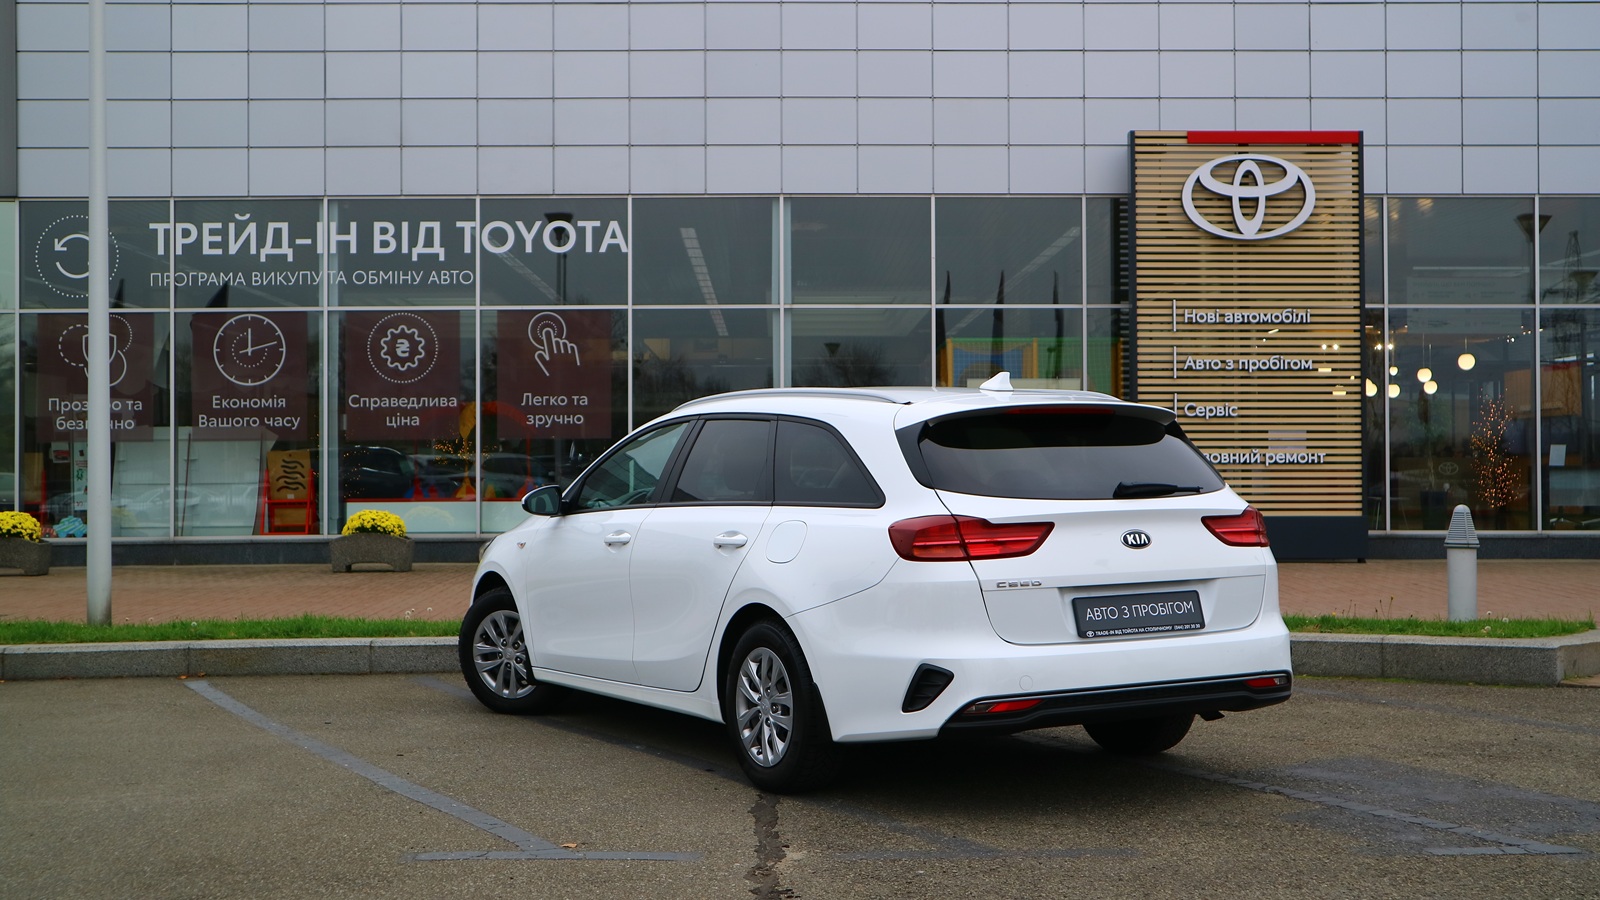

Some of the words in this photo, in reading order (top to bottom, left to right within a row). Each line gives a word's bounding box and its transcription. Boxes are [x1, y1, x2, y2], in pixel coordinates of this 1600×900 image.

[149, 213, 357, 262] ТРЕЙД-ІН
[373, 221, 445, 261] ВІД
[456, 220, 628, 254] TOYOTA
[150, 272, 246, 287] ПРОГРАМА
[252, 271, 322, 286] ВИКУПУ
[326, 271, 347, 285] ТА
[352, 270, 423, 285] ОБМІНУ
[428, 270, 473, 285] АВТО
[1184, 309, 1219, 323] Нові
[1224, 309, 1311, 324] автомобілі
[1184, 356, 1221, 370] Авто
[1226, 359, 1233, 370] з
[1238, 355, 1313, 372] пробігом
[48, 398, 122, 414] Прозо
[126, 400, 143, 411] та
[212, 395, 286, 409] Економія
[348, 394, 457, 409] Справедлива
[521, 393, 567, 407] Легко
[571, 395, 588, 406] та
[1184, 403, 1238, 419] Сервіс
[56, 416, 135, 430] безно
[198, 414, 259, 429] Вашого
[264, 417, 301, 431] часу
[386, 413, 420, 427] ціна
[526, 415, 584, 428] зручно
[1203, 449, 1261, 464] зовний
[1265, 452, 1326, 466] ремонт
[1126, 533, 1149, 545] KIA
[1086, 606, 1119, 621] АВТО
[1121, 605, 1130, 619] З
[1132, 601, 1195, 617] ПРОБІГОМ
